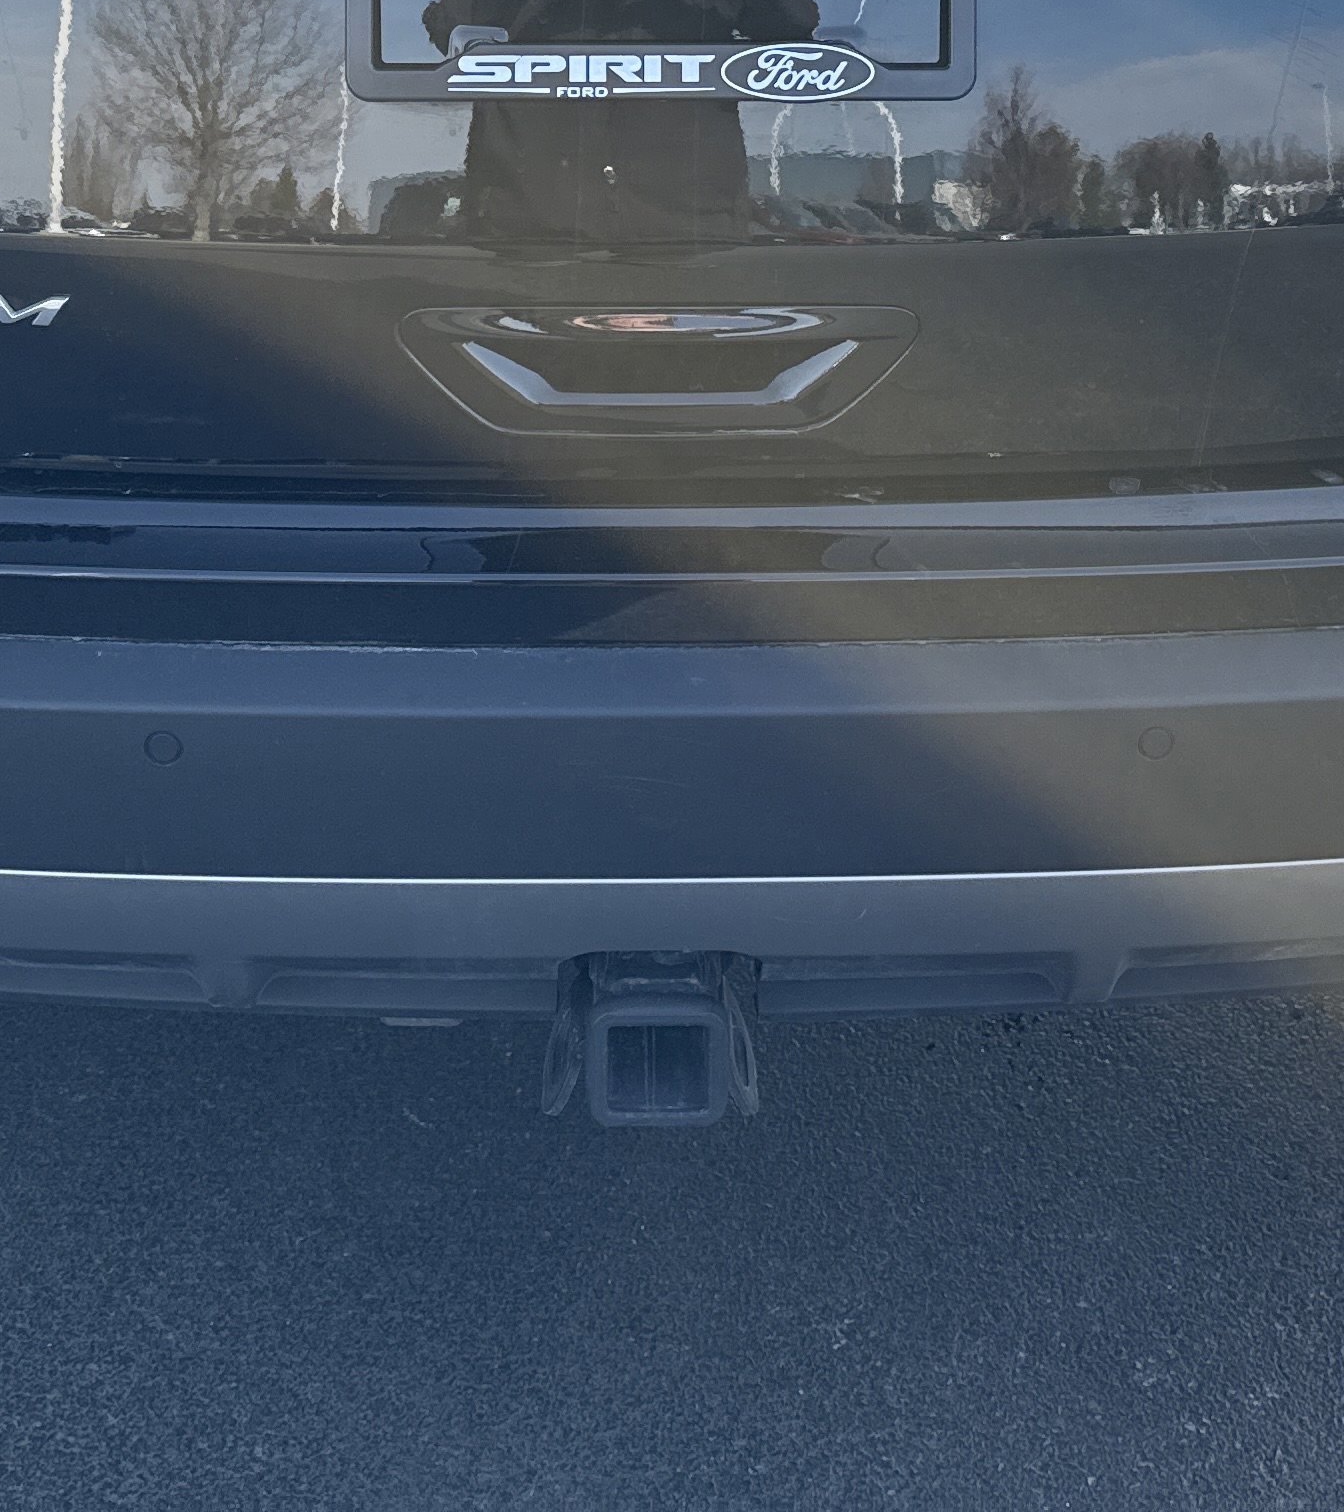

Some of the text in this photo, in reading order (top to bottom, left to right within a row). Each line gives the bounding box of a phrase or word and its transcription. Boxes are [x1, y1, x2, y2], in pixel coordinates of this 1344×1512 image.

[446, 54, 716, 83] SPIRIT
[747, 49, 848, 91] Ford
[556, 86, 608, 98] FORD
